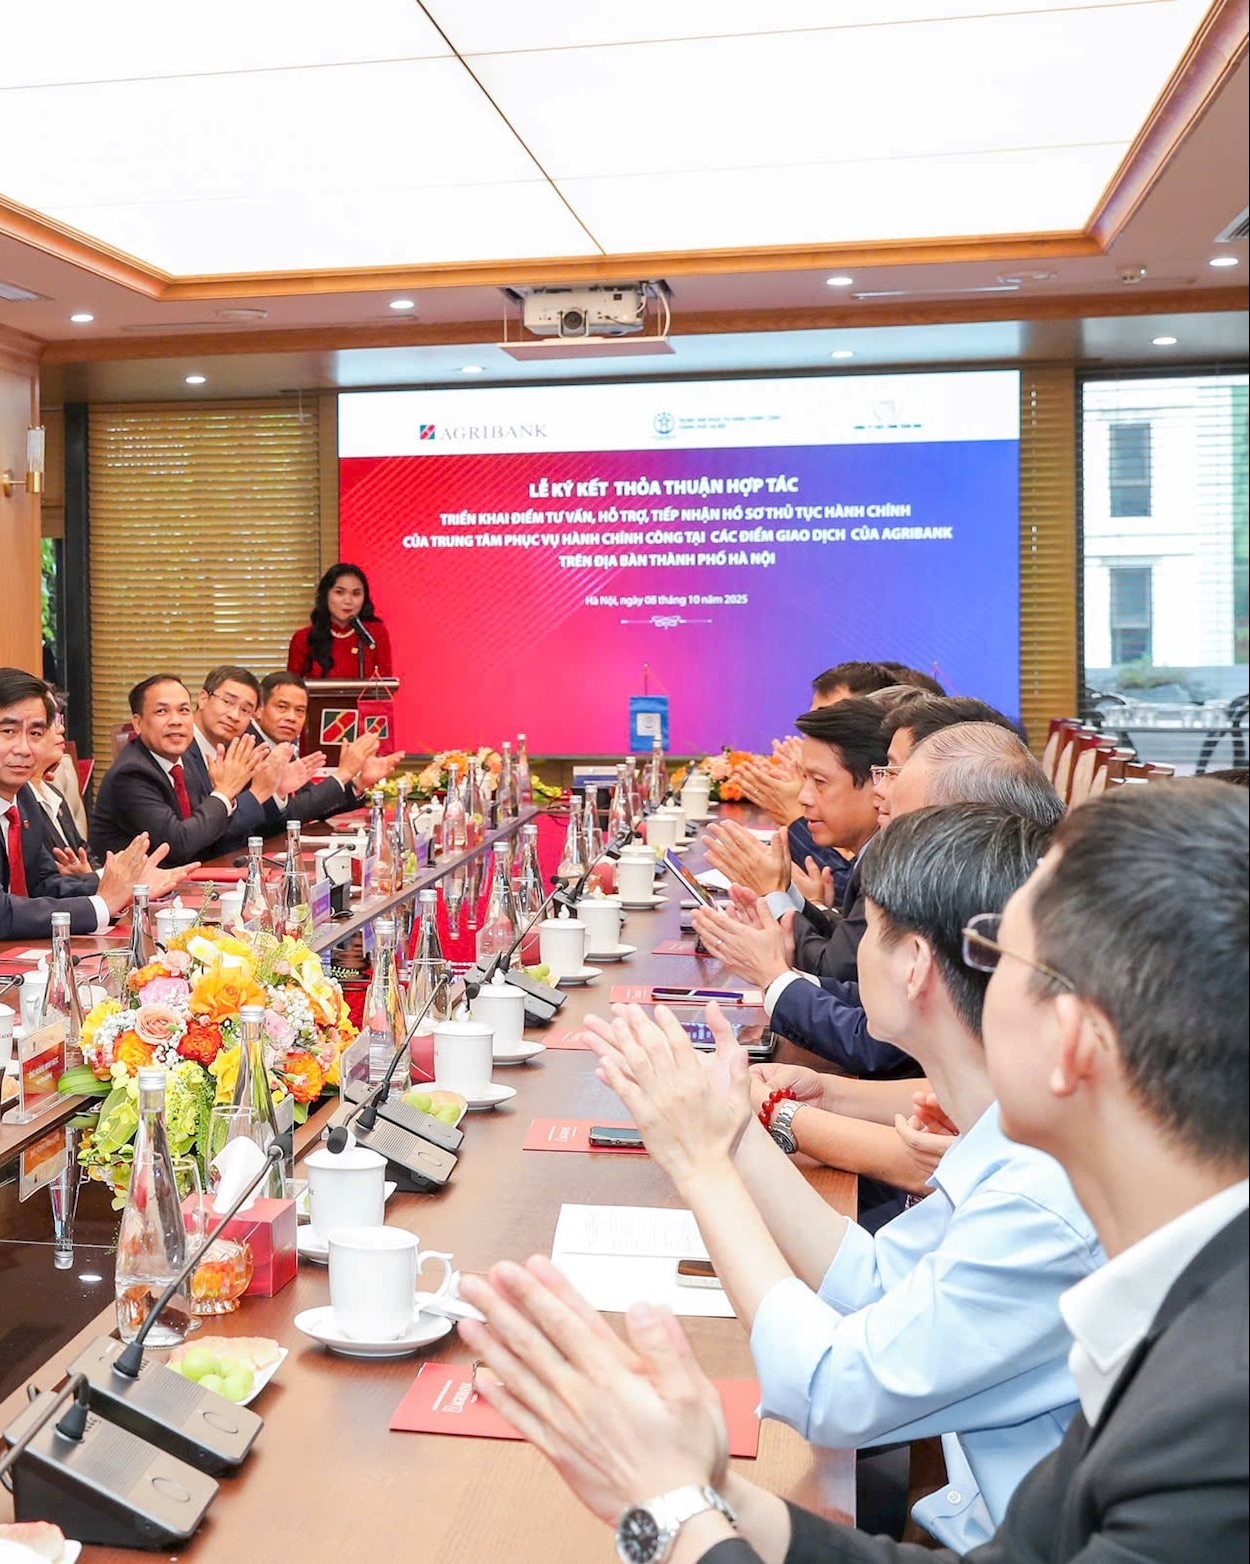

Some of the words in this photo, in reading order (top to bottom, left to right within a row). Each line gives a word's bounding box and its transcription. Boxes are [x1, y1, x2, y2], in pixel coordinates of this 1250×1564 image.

[440, 424, 547, 441] AGRIBANK
[529, 477, 550, 498] LỄ
[551, 479, 574, 498] KÝ
[576, 477, 608, 497] KẾT
[614, 476, 662, 496] THỎA
[663, 476, 723, 498] THUẬN
[726, 477, 764, 497] HỢP
[765, 475, 799, 493] TÁC
[478, 511, 510, 525] KHAI
[546, 510, 566, 524] TƯ
[651, 507, 679, 522] TIẾP
[681, 507, 720, 524] NHẬN
[744, 506, 766, 520] SƠ
[796, 506, 822, 522] TỤC
[824, 503, 865, 519] HÀNH
[866, 502, 911, 518] CHÍNH
[402, 532, 429, 549] CỦA
[430, 534, 474, 548] TRUNG
[475, 533, 503, 547] TÂM
[504, 534, 539, 549] PHỤC
[540, 533, 560, 548] VỤ
[562, 531, 600, 545] HÀNH
[601, 530, 643, 545] CHÍNH
[645, 530, 683, 544] CÔNG
[684, 530, 705, 546] TẠI
[710, 528, 739, 544] CÁC
[775, 528, 810, 542] GIAO
[812, 528, 846, 544] DỊCH
[850, 525, 880, 541] CỦA
[881, 526, 954, 541] AGRIBANK
[559, 553, 593, 568] TRÊN
[594, 554, 618, 570] ĐỊA
[620, 552, 648, 567] BÀN
[648, 551, 696, 566] THÀNH
[728, 551, 749, 566] HÀ
[750, 551, 776, 568] NỘI
[585, 595, 599, 606] Hà
[600, 595, 619, 607] Nội,
[620, 595, 643, 607] ngày
[658, 594, 687, 607] tháng
[688, 594, 700, 605] 10
[701, 594, 723, 605] năm
[724, 594, 748, 605] 2025
